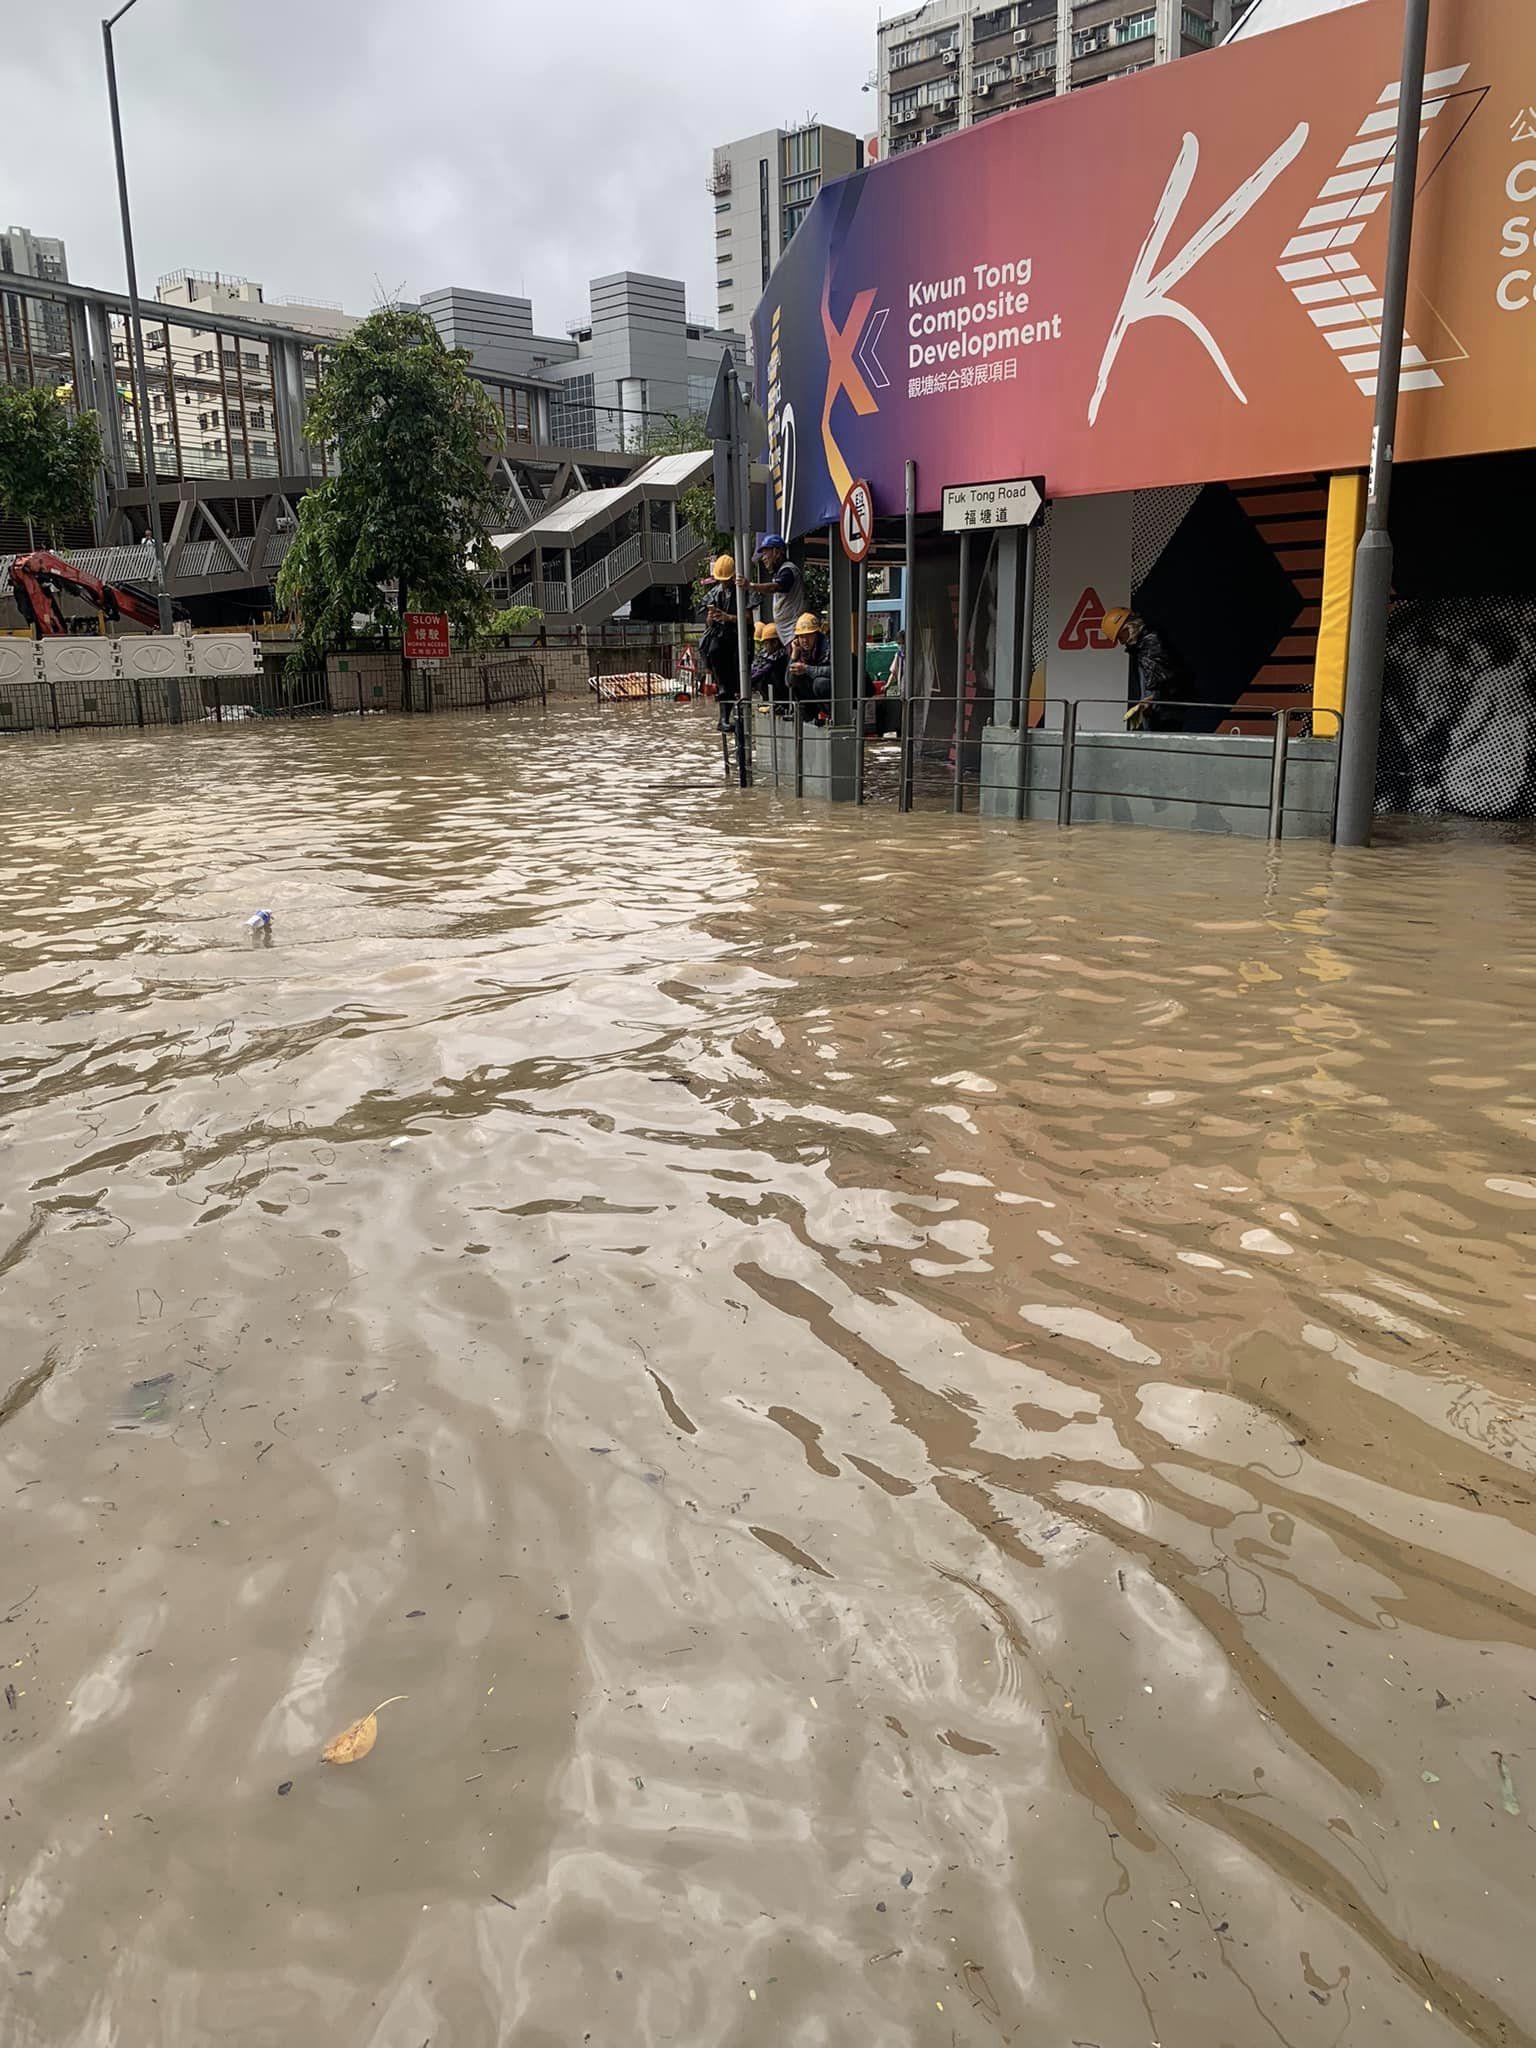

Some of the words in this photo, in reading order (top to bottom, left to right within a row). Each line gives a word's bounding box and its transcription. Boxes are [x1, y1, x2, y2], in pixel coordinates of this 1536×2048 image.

[908, 275, 966, 308] Kwun
[973, 258, 1032, 290] Tong
[1087, 121, 1310, 428] K
[908, 291, 1029, 337] Composite
[909, 314, 1062, 368] Development
[908, 358, 1017, 399] 觀塘綜合發展項目
[948, 492, 966, 504] Fuk
[970, 490, 995, 503] Tong
[998, 486, 1026, 499] Road
[964, 507, 1008, 525] 福塘道
[412, 615, 441, 624] SLOW
